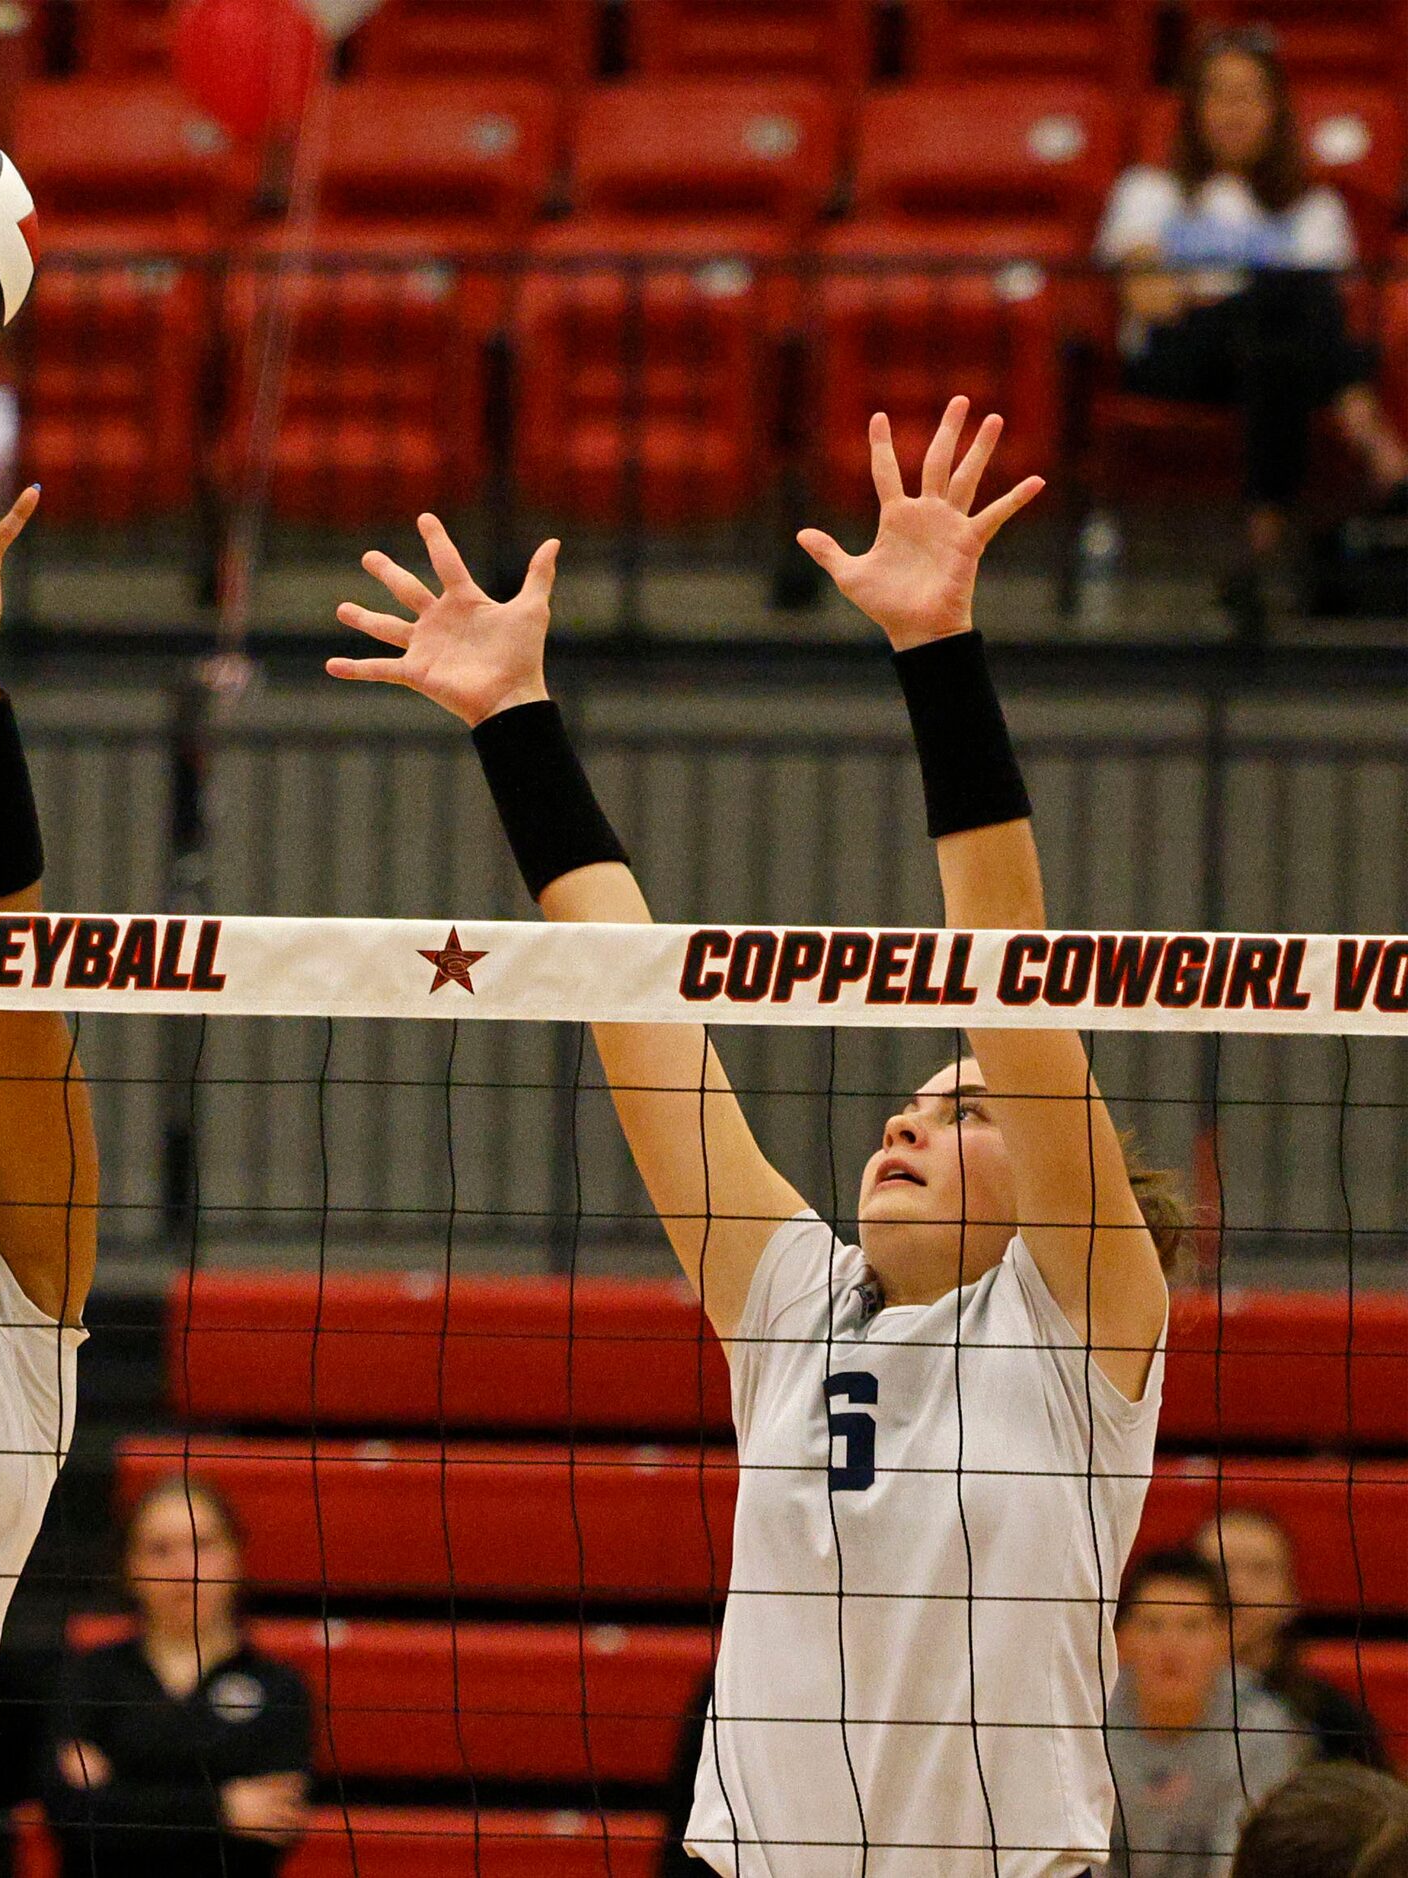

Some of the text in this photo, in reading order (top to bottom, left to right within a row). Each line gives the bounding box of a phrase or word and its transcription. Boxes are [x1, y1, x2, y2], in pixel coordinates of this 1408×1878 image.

[679, 929, 978, 1006] COPPELL
[986, 934, 1311, 1010] COWGIRL
[823, 1371, 878, 1491] 6
